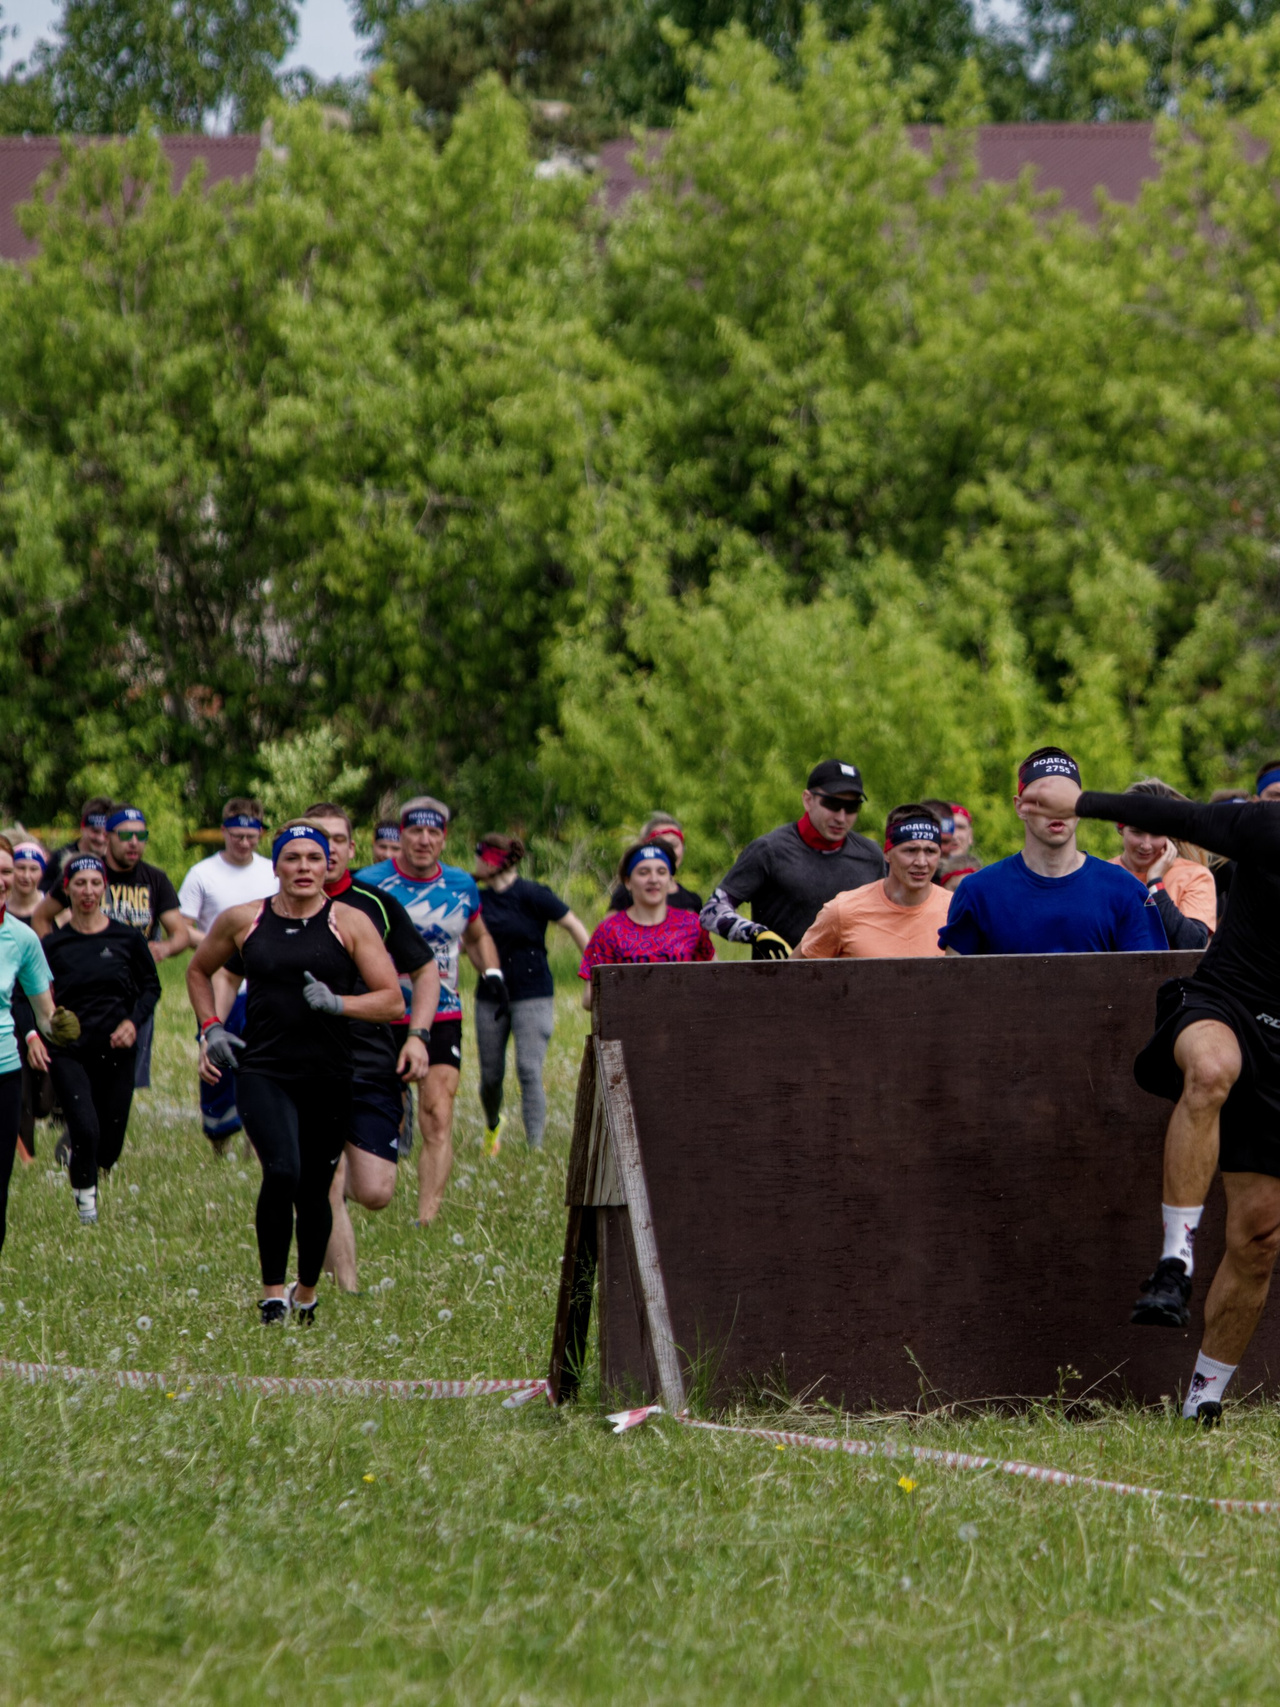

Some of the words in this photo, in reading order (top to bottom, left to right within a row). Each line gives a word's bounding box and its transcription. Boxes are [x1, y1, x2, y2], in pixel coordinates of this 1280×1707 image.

[1033, 757, 1067, 768] РОДЕО
[1045, 764, 1071, 774] 2755
[900, 822, 932, 834] РОДЕО
